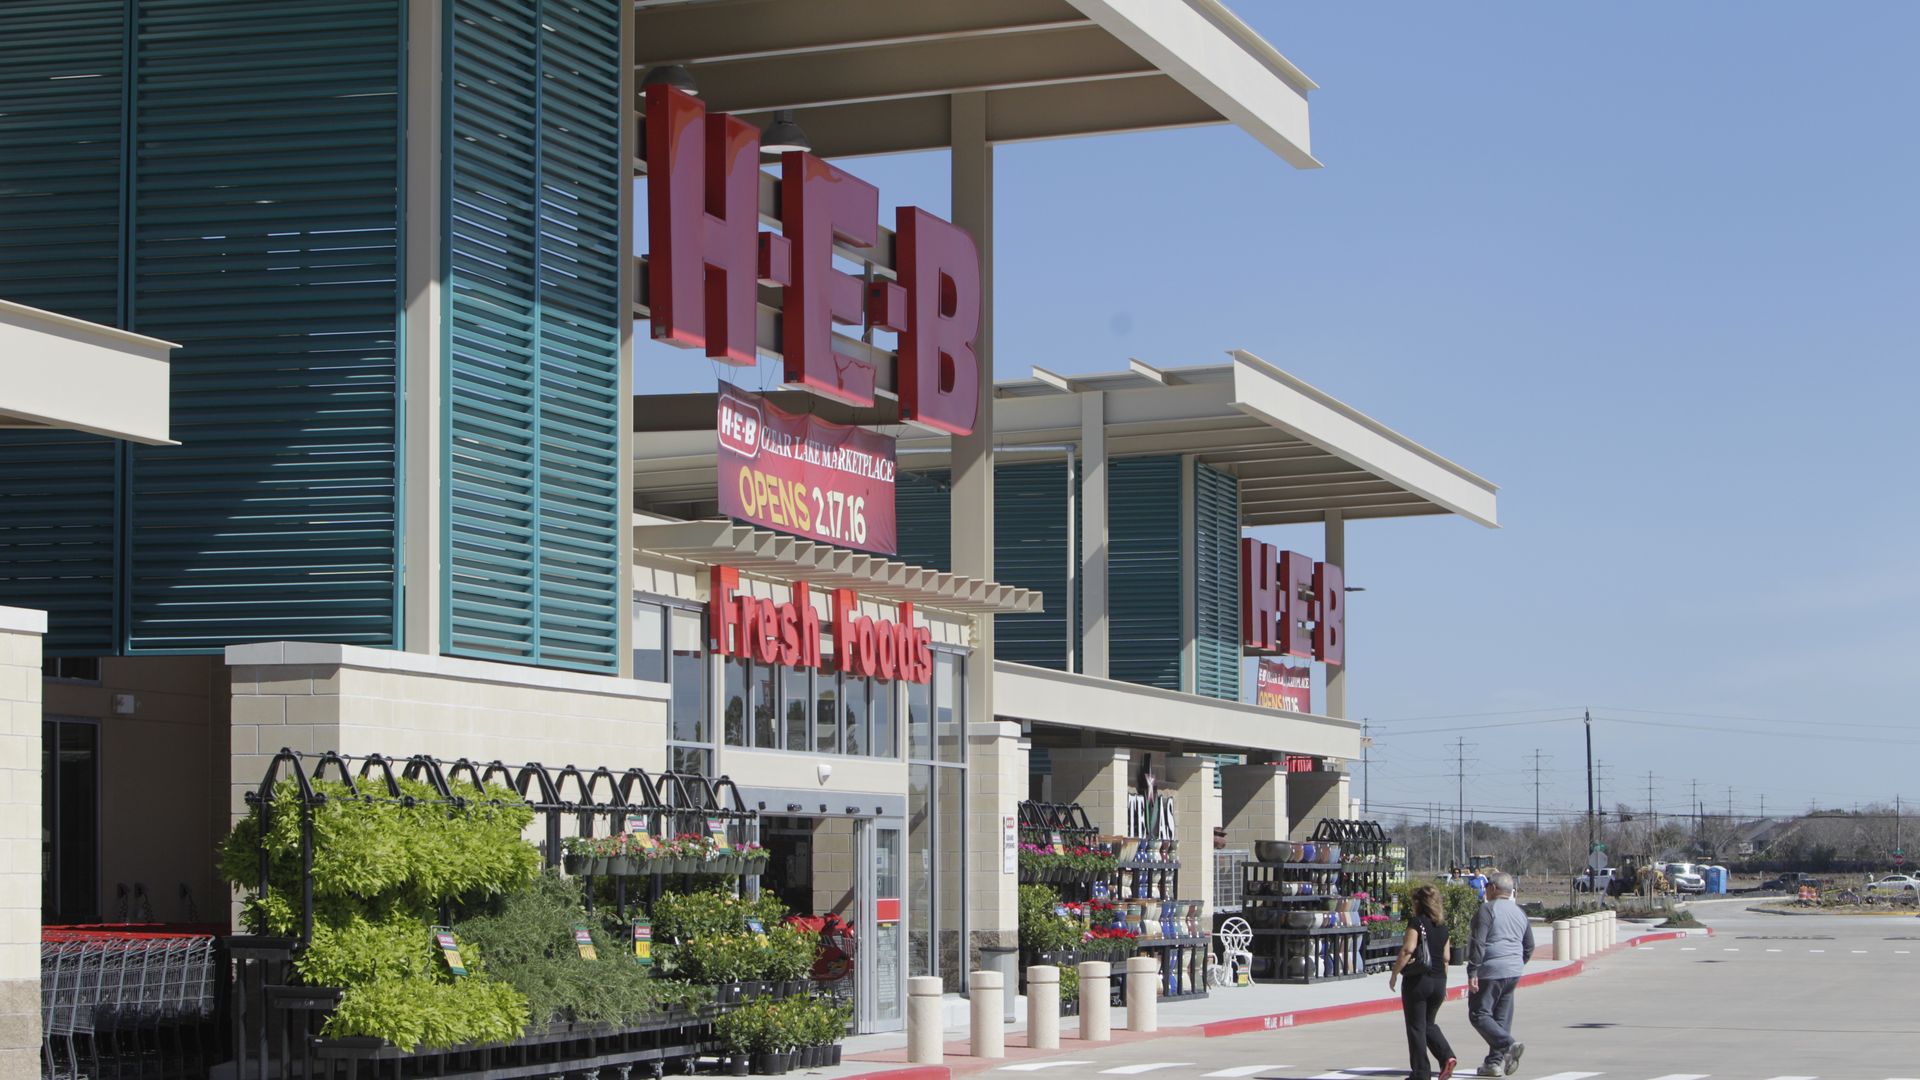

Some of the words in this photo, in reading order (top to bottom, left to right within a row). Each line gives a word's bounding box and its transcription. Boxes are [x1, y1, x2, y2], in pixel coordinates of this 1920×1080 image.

[645, 83, 981, 436] H-E-B
[761, 426, 792, 458] CLEAR
[795, 436, 821, 466] LAKE
[821, 444, 895, 483] MARKETPLACE
[739, 465, 811, 532] OPENS
[812, 487, 867, 544] 2.17.16
[710, 565, 821, 667] Fresh
[832, 588, 932, 685] Foods
